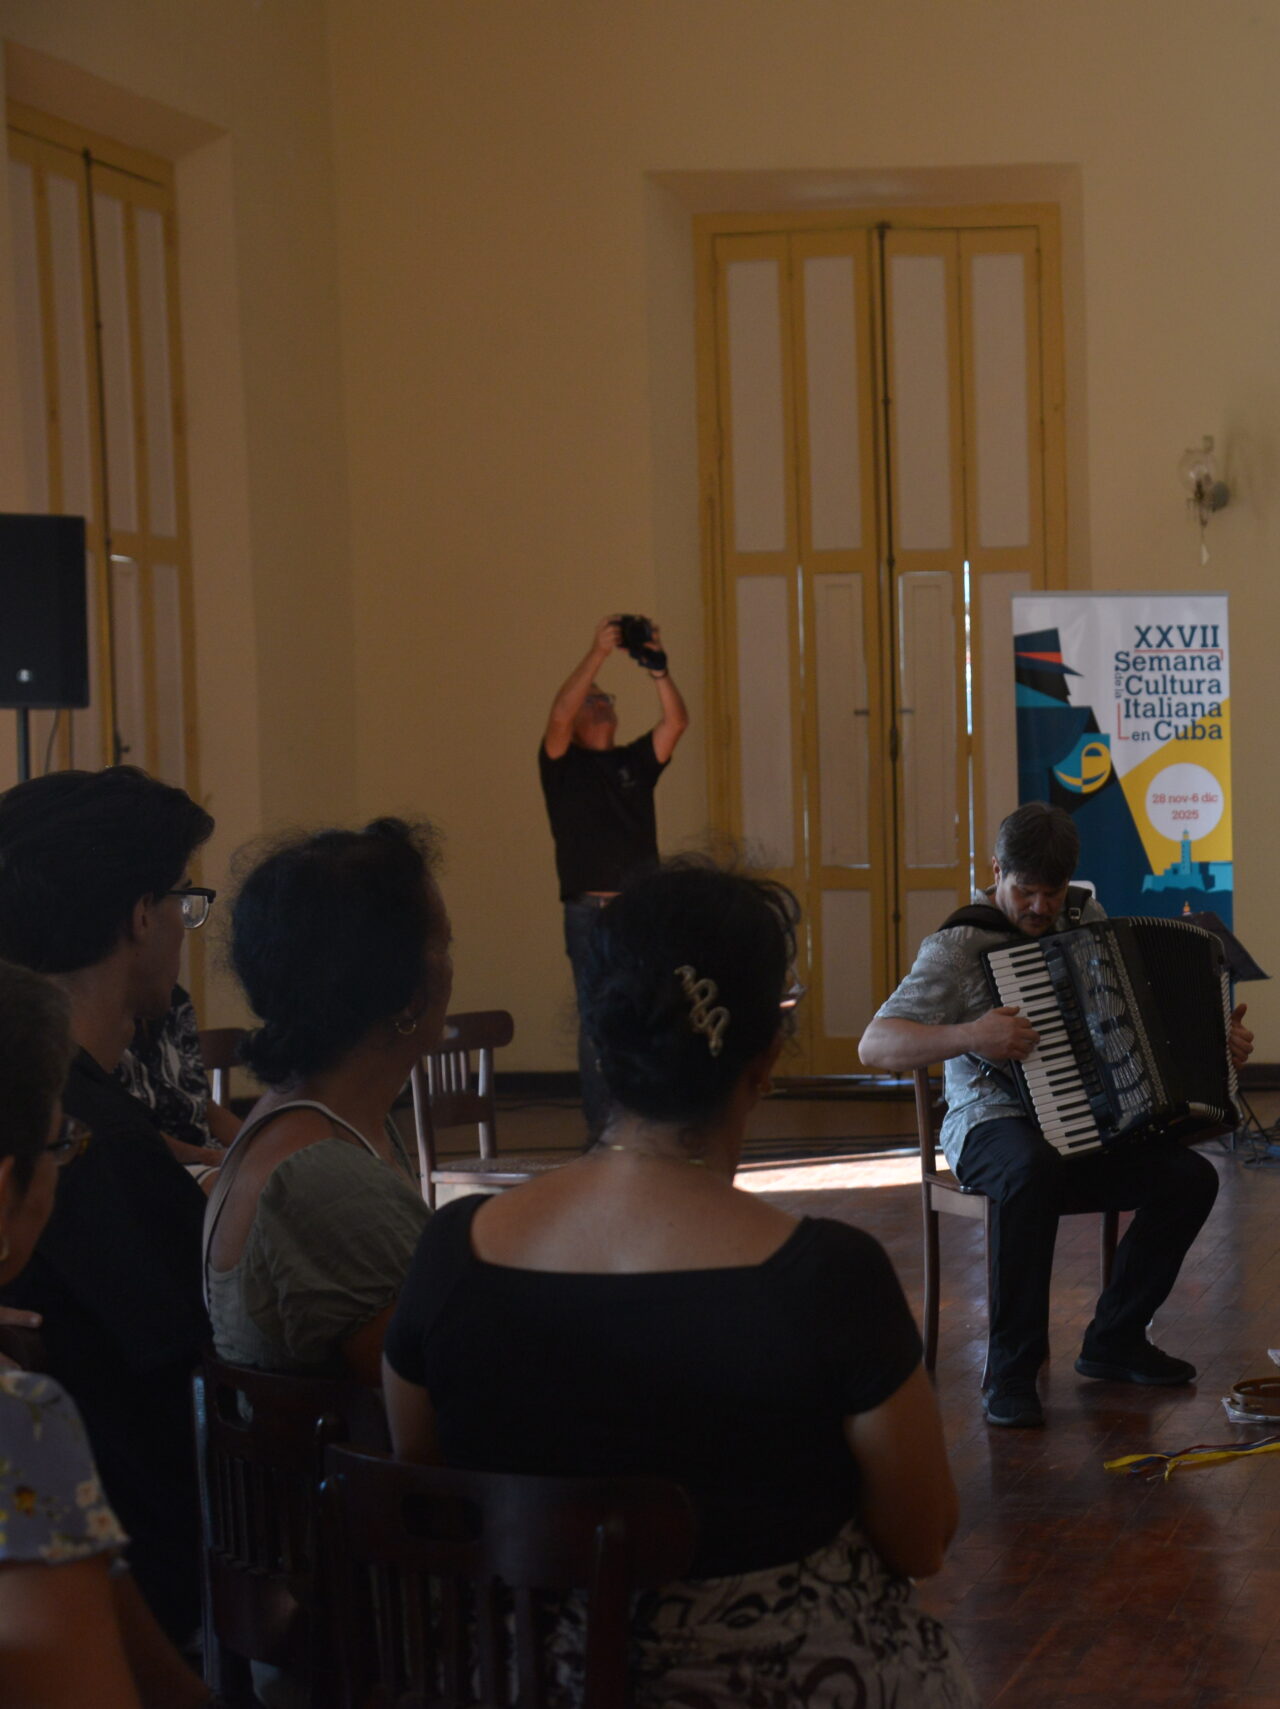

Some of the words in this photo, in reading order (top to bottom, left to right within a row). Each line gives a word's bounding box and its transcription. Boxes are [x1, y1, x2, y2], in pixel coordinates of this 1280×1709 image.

[1134, 625, 1220, 649] XXVII
[1114, 651, 1222, 672] Semana
[1125, 674, 1222, 696] Cultura
[1124, 697, 1223, 720] Italiana
[1131, 730, 1151, 741] en
[1153, 720, 1223, 741] Cuba
[1152, 793, 1166, 804] 28
[1171, 810, 1200, 820] 2025
